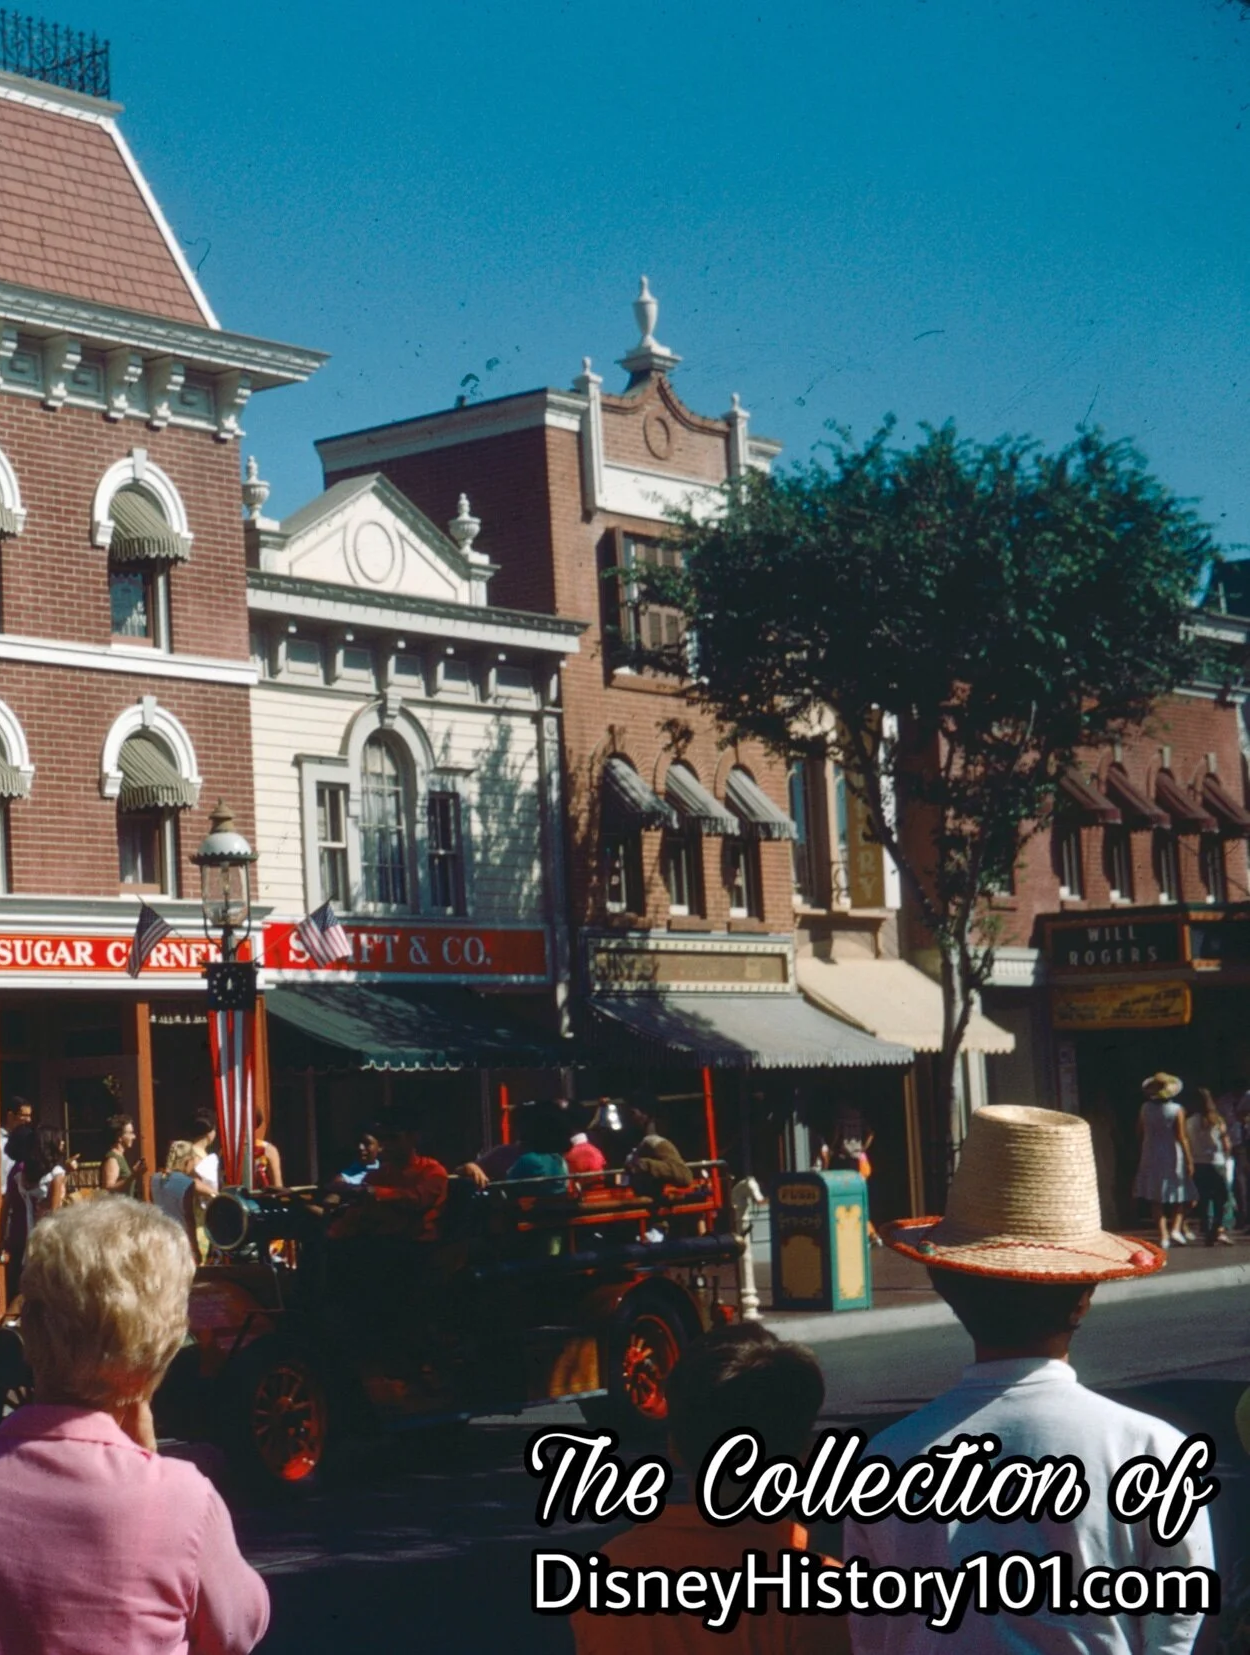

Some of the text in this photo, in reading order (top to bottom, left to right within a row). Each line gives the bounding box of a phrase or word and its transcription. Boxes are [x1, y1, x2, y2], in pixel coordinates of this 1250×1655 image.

[1087, 925, 1137, 941] WILL
[288, 931, 493, 966] SIFT & CO.
[1068, 946, 1158, 966] ROGERS
